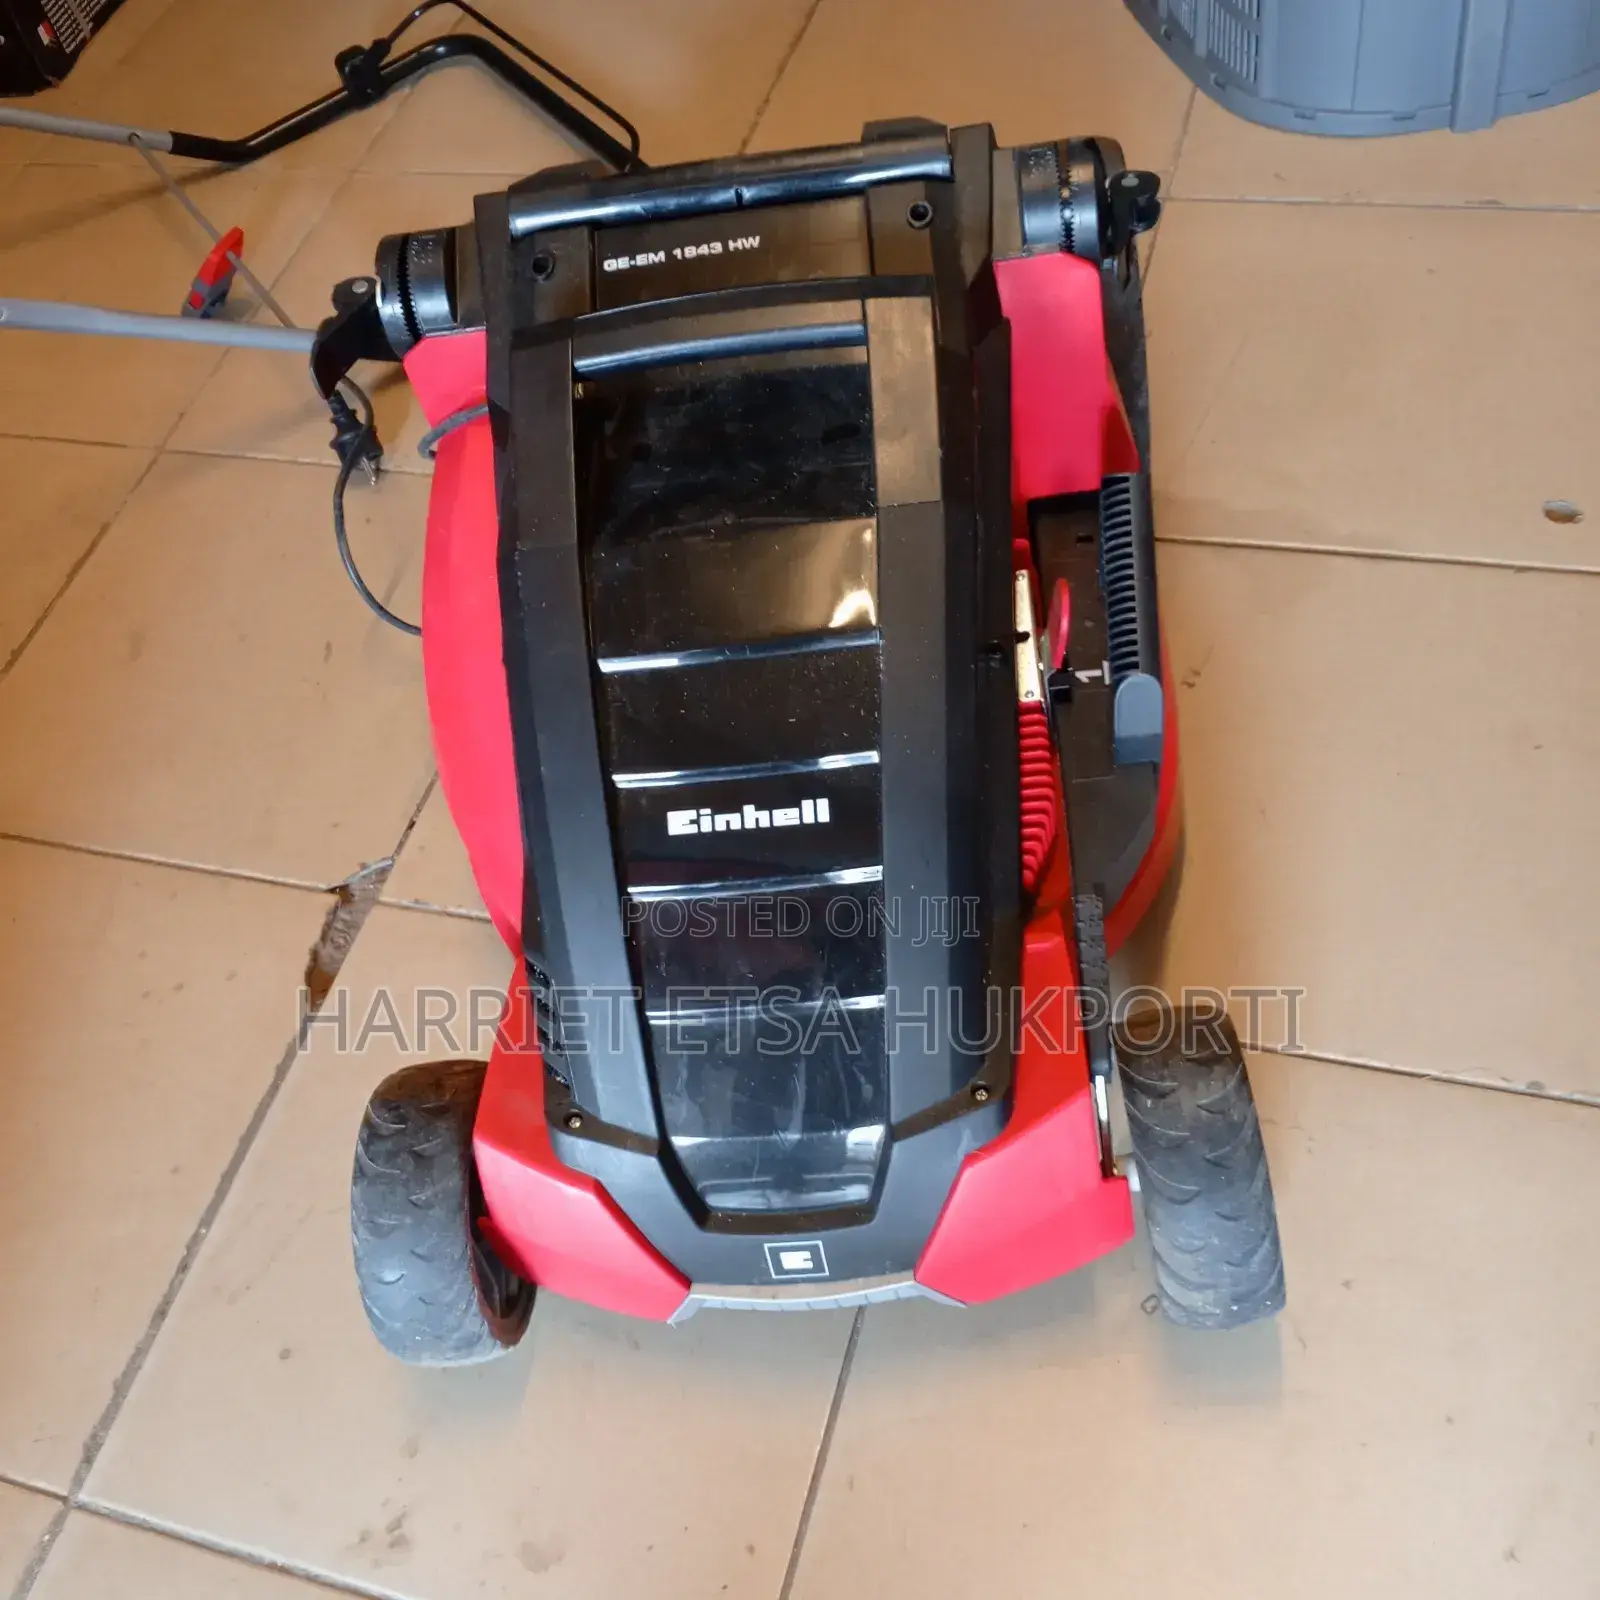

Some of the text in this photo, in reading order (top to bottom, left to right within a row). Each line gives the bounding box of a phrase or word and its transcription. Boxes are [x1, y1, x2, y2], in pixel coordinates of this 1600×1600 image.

[672, 241, 723, 261] 1843
[728, 235, 761, 252] HW
[666, 798, 831, 836] Einhell
